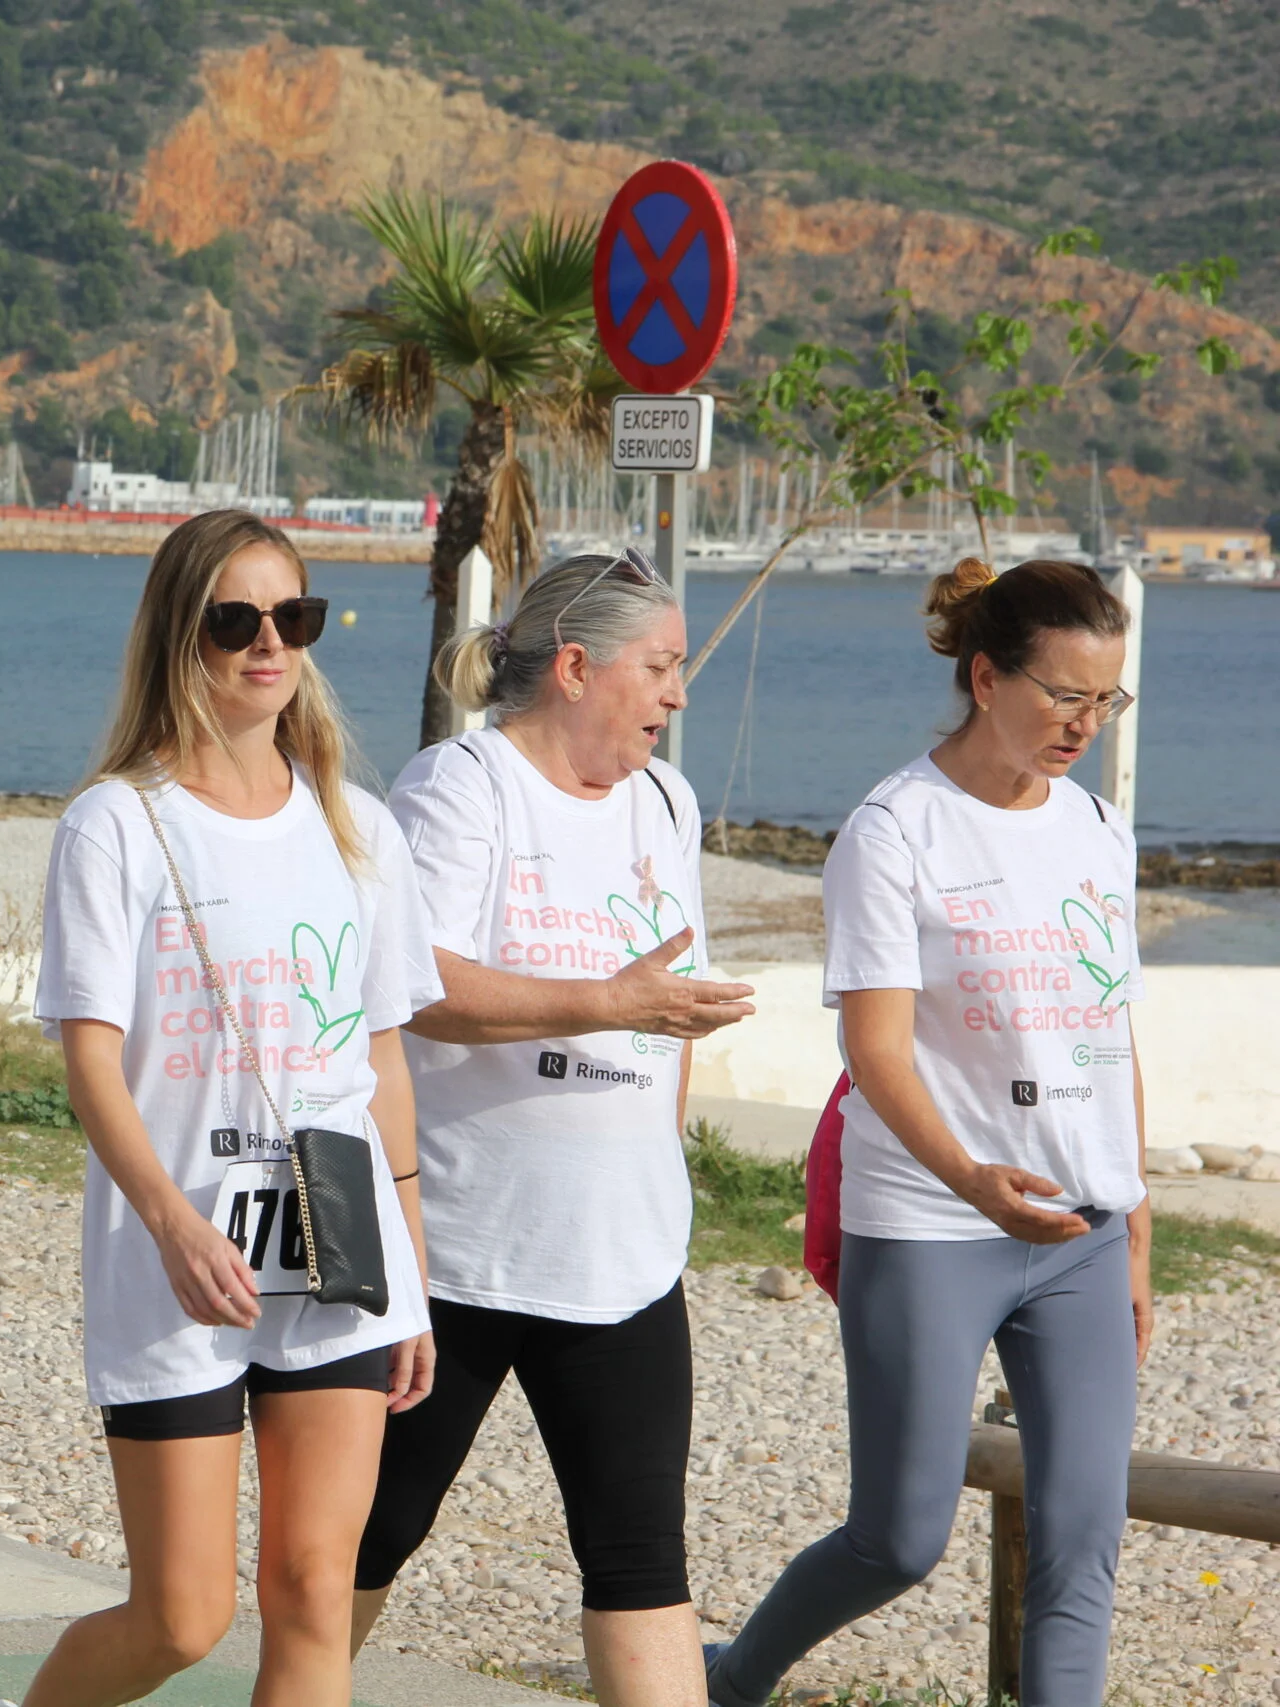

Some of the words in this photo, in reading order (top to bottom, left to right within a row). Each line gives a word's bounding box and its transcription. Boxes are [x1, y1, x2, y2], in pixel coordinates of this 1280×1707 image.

[623, 410, 689, 430] EXCEPTO
[618, 439, 692, 459] SERVICIOS
[503, 901, 637, 942] marcha
[941, 895, 996, 925] En
[953, 921, 1090, 957] marcha
[156, 948, 315, 996] marcha
[499, 939, 622, 976] contra
[957, 959, 1072, 994] contra
[963, 1000, 1001, 1032] el
[1010, 998, 1116, 1033] cáncer
[164, 1041, 207, 1080] el
[226, 1188, 310, 1271] 476
